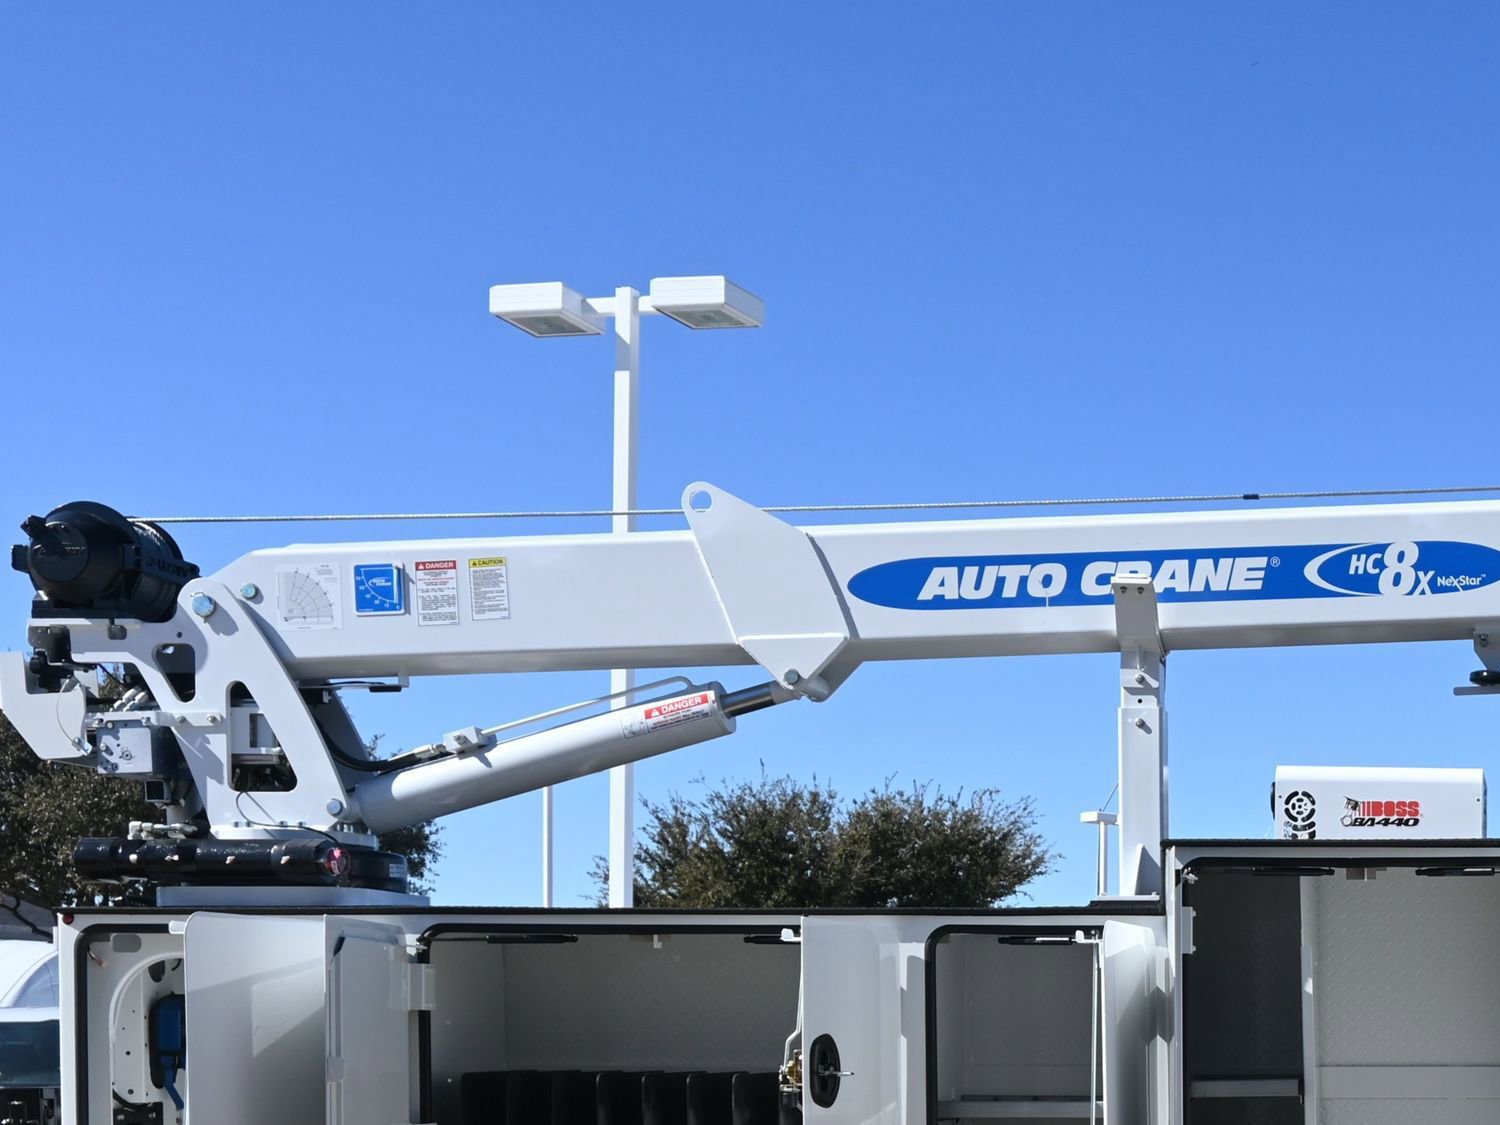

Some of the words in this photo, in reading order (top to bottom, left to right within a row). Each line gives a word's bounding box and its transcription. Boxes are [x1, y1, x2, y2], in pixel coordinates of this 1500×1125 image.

[917, 563, 1067, 600] AUTO
[1437, 575, 1482, 589] NexStar
[661, 696, 702, 713] DANGER
[1372, 801, 1419, 816] BOSS
